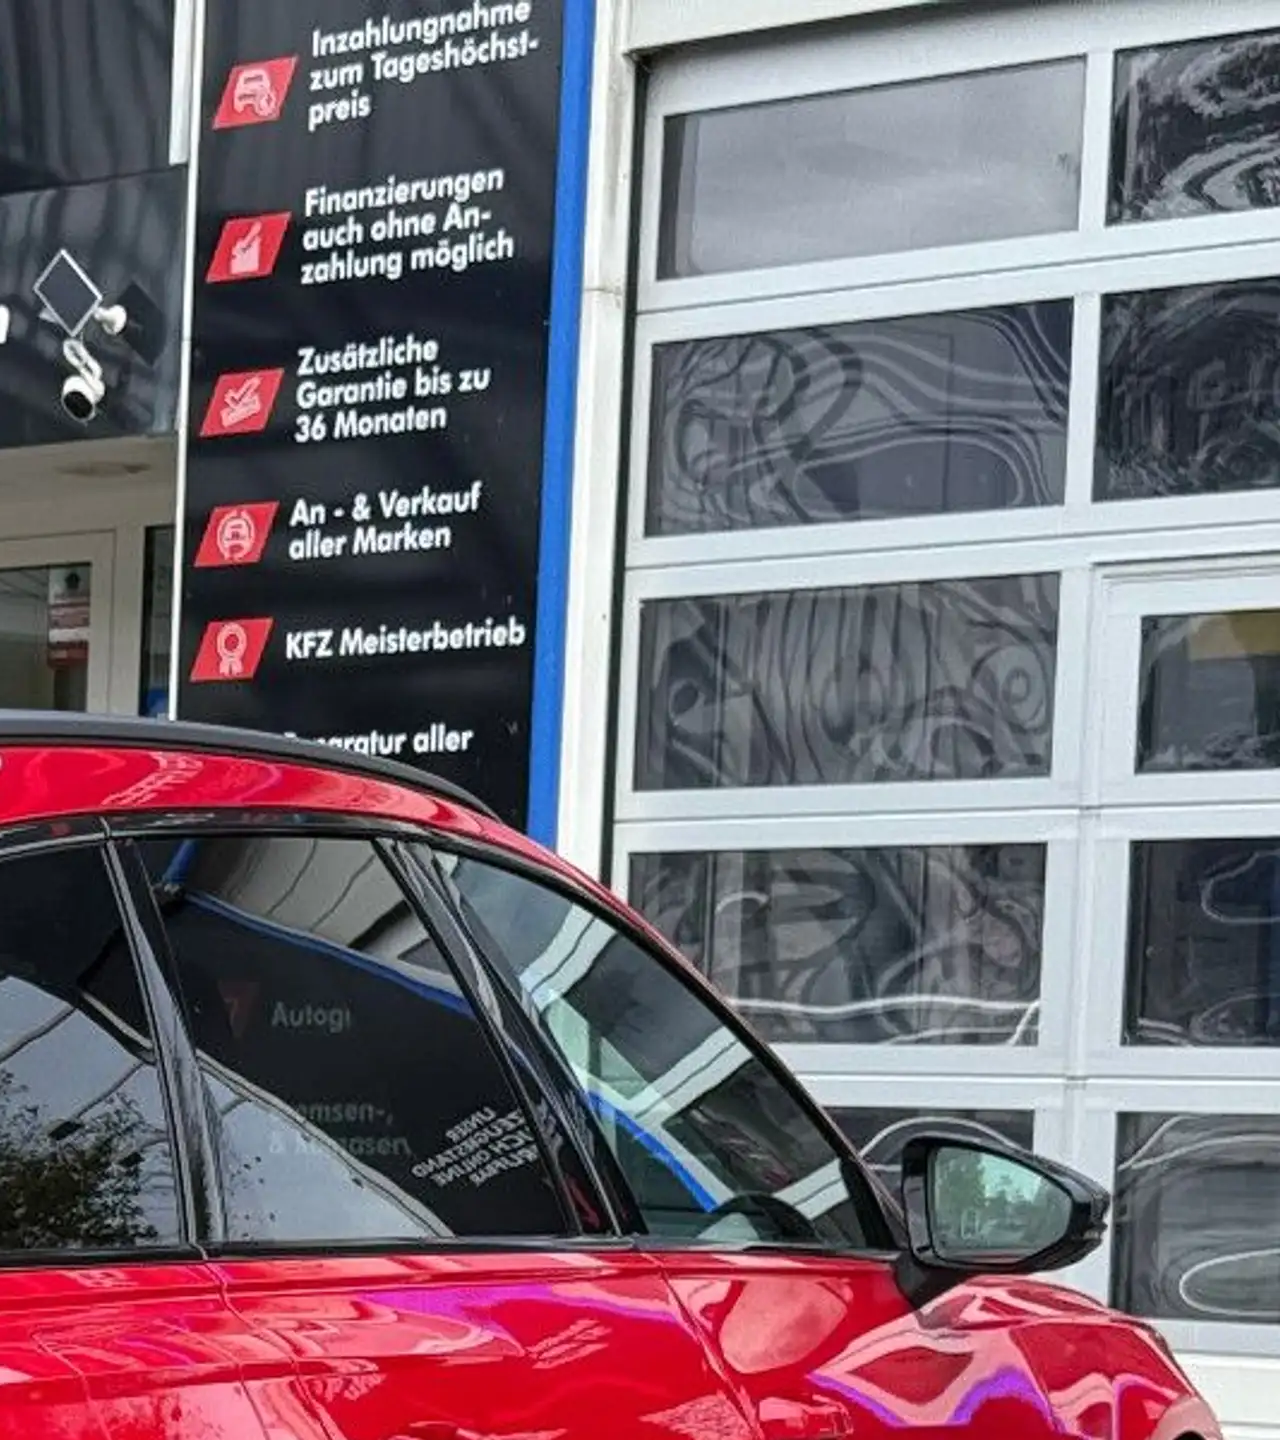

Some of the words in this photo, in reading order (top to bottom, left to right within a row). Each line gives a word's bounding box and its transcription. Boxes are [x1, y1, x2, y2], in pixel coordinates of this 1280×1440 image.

[312, 0, 532, 57] Inzahlungnahme
[310, 61, 363, 91] zum
[371, 29, 539, 83] Tageshöchst-
[308, 88, 372, 132] preis
[305, 168, 504, 217] Finanzierungen
[302, 215, 363, 251] auch
[370, 209, 436, 241] ohne
[442, 202, 492, 231] An-
[300, 248, 403, 284] zahlung
[410, 228, 514, 272] möglich
[296, 333, 439, 376] Zusätzliche
[296, 370, 407, 409] Garantie
[414, 365, 452, 397] bis
[458, 367, 491, 392] zu
[294, 413, 327, 443] 36
[333, 404, 447, 440] Monaten
[352, 492, 371, 521] &
[378, 479, 482, 519] Verkauf
[288, 528, 347, 560] aller
[353, 520, 451, 555] Marken
[285, 629, 334, 660] KFZ
[339, 614, 526, 656] Meisterbetrieb
[284, 730, 407, 756] aratur
[413, 723, 474, 753] aller
